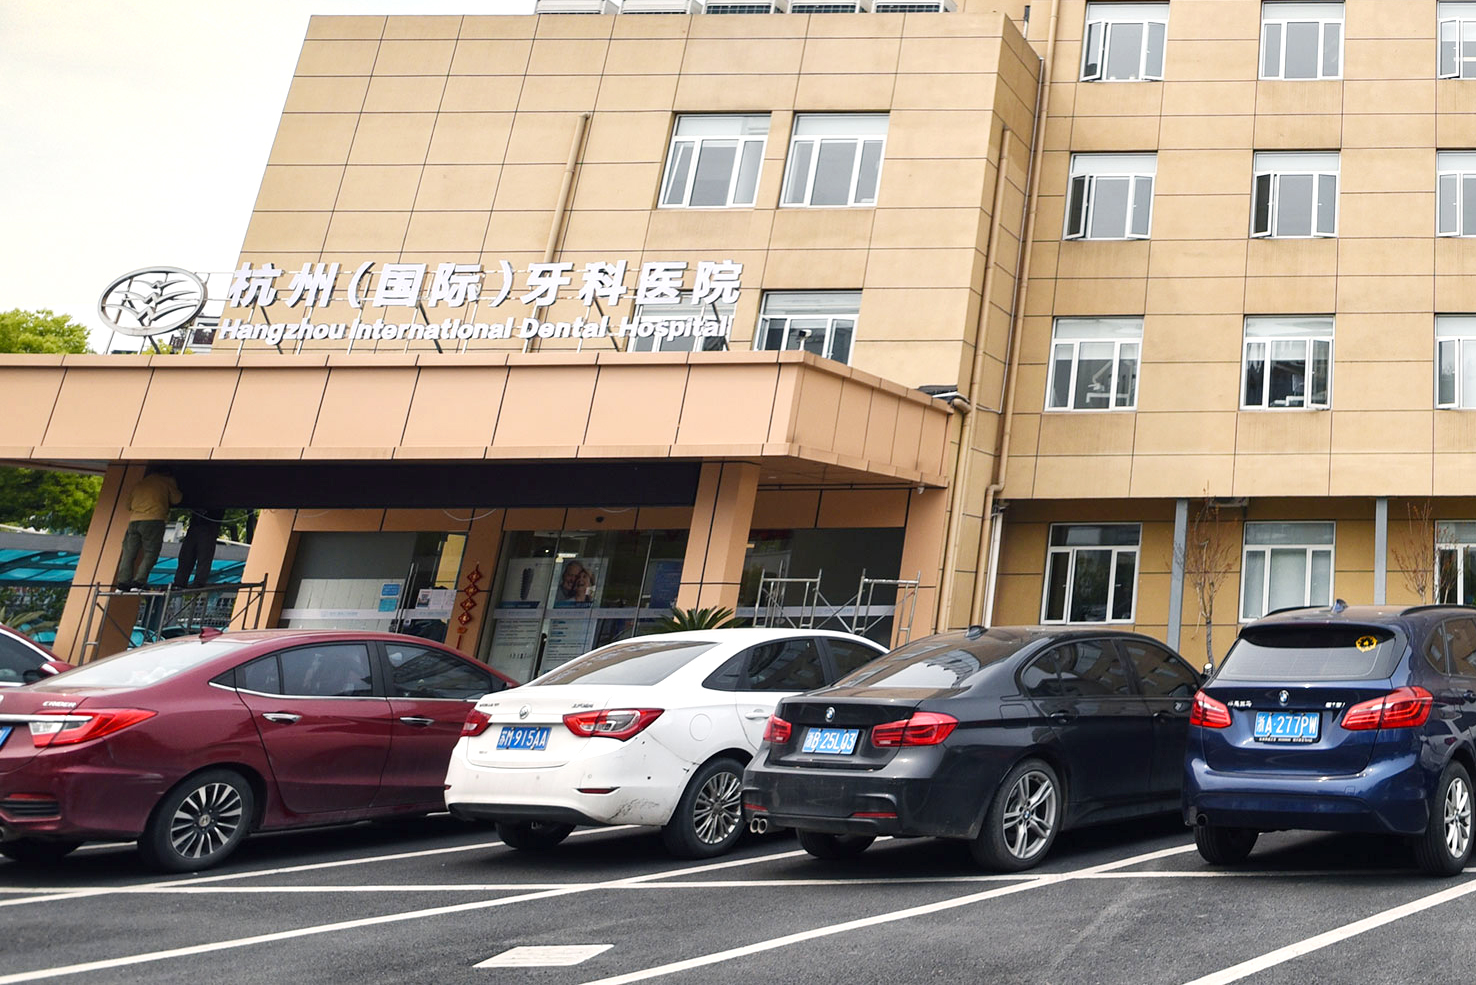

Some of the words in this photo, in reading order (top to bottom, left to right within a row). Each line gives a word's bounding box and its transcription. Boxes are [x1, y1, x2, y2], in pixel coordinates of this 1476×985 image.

[228, 259, 744, 308] 杭州（国际）牙科医院
[218, 317, 346, 345] Hangzhou
[349, 316, 516, 340] International
[519, 315, 611, 339] Dental
[618, 315, 729, 341] Hospital
